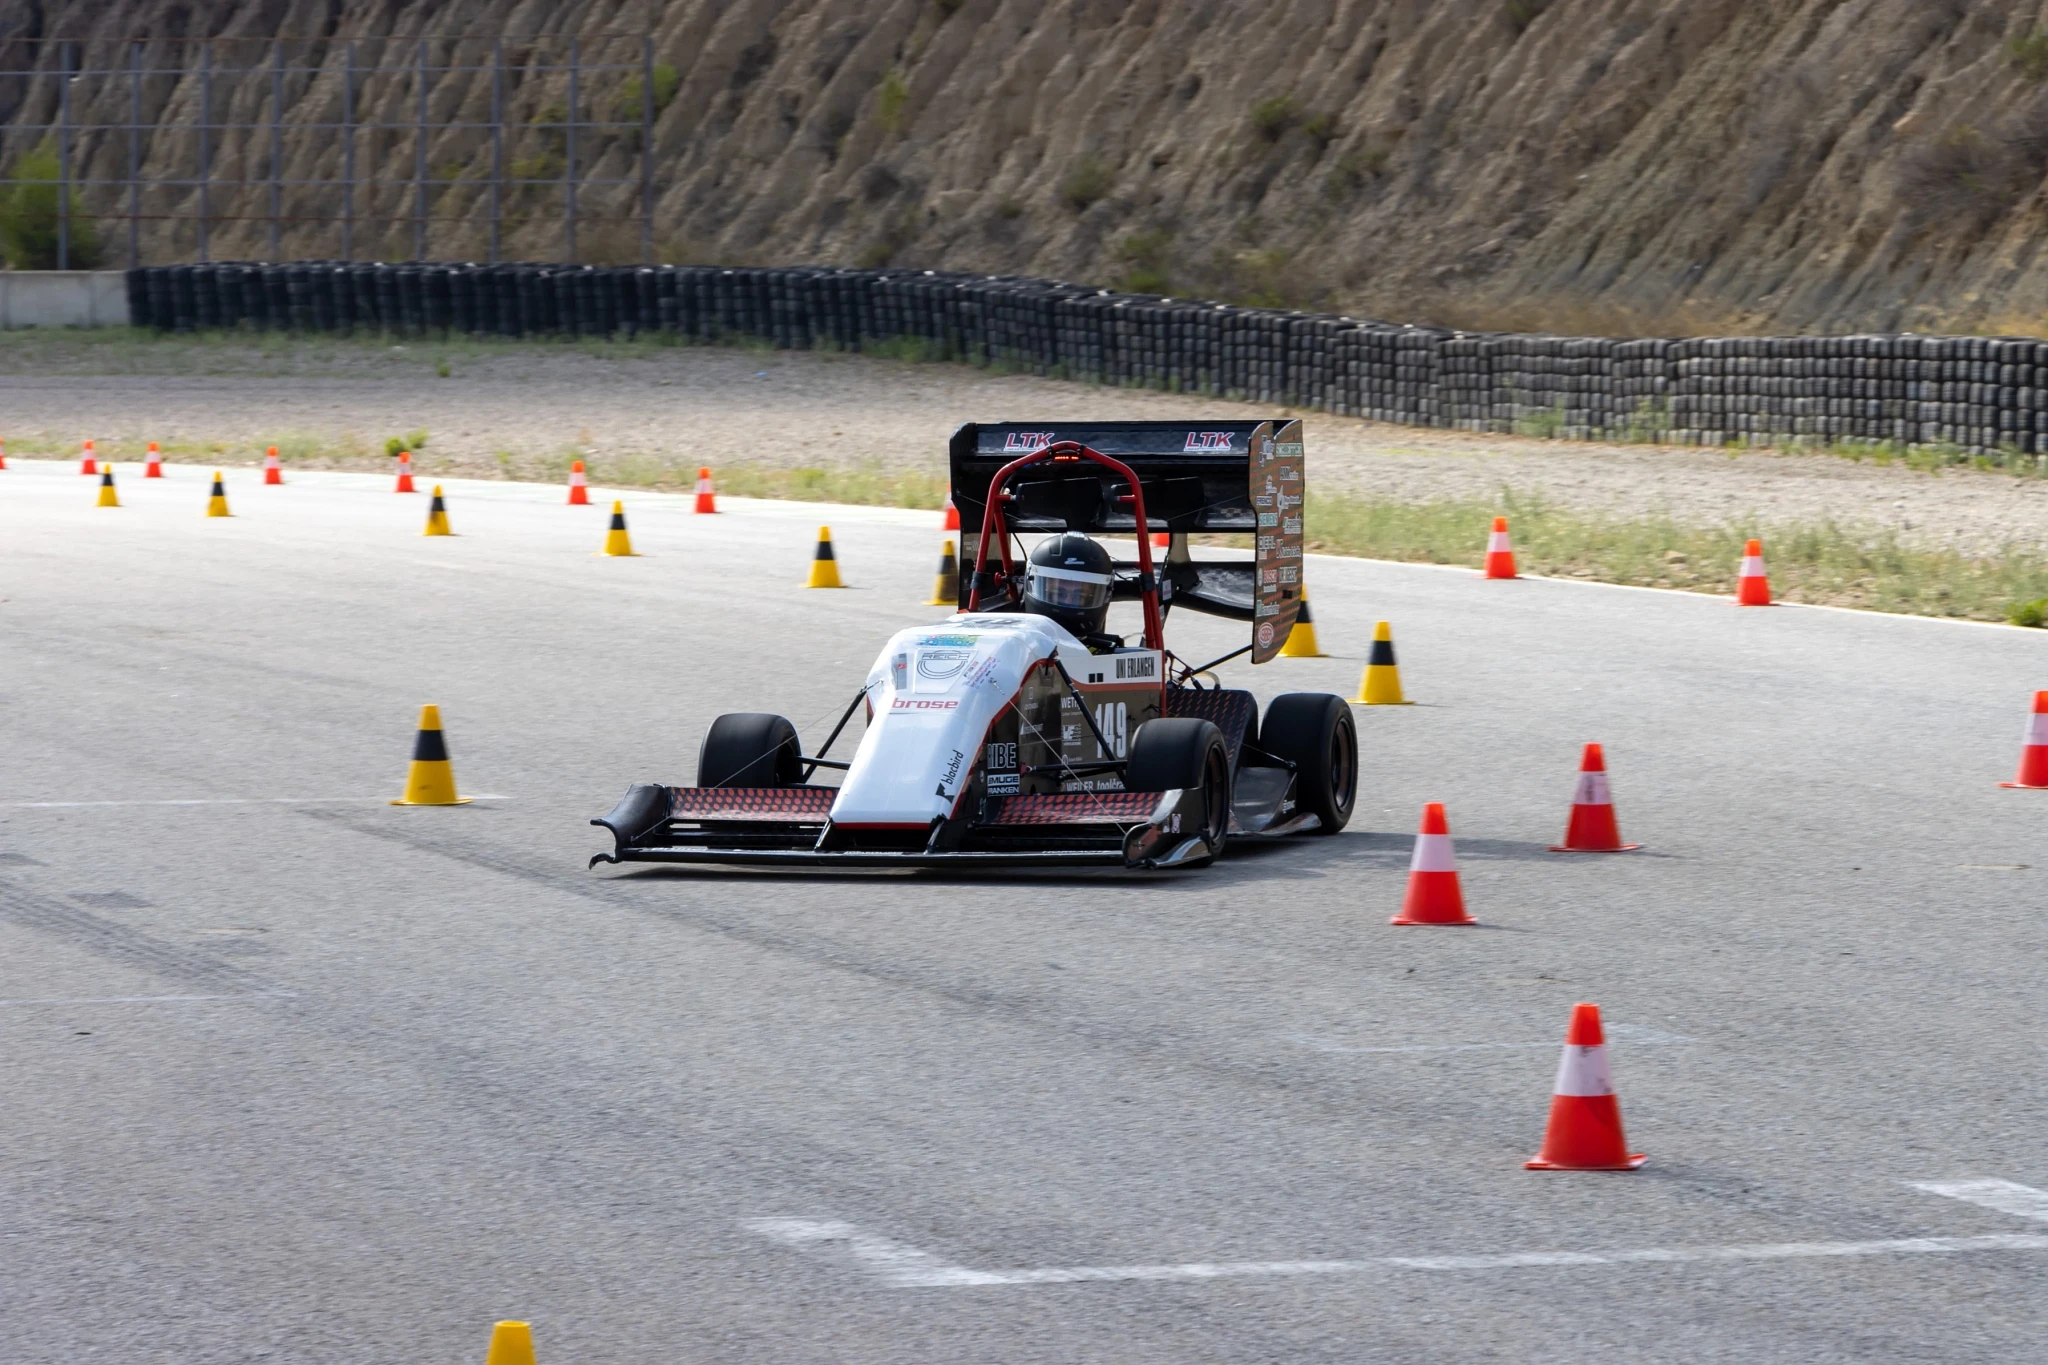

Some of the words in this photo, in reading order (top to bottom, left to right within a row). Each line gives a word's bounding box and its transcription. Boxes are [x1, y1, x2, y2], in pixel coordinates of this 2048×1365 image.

[1005, 433, 1055, 448] LTK
[1185, 432, 1235, 447] LTK
[1259, 513, 1278, 526] SIEMENS
[921, 653, 970, 661] REICH
[1116, 658, 1126, 679] UNI
[1127, 657, 1155, 678] ERLANGEN
[892, 698, 959, 709] brose
[1095, 702, 1127, 758] 149
[941, 749, 965, 785] blacbird
